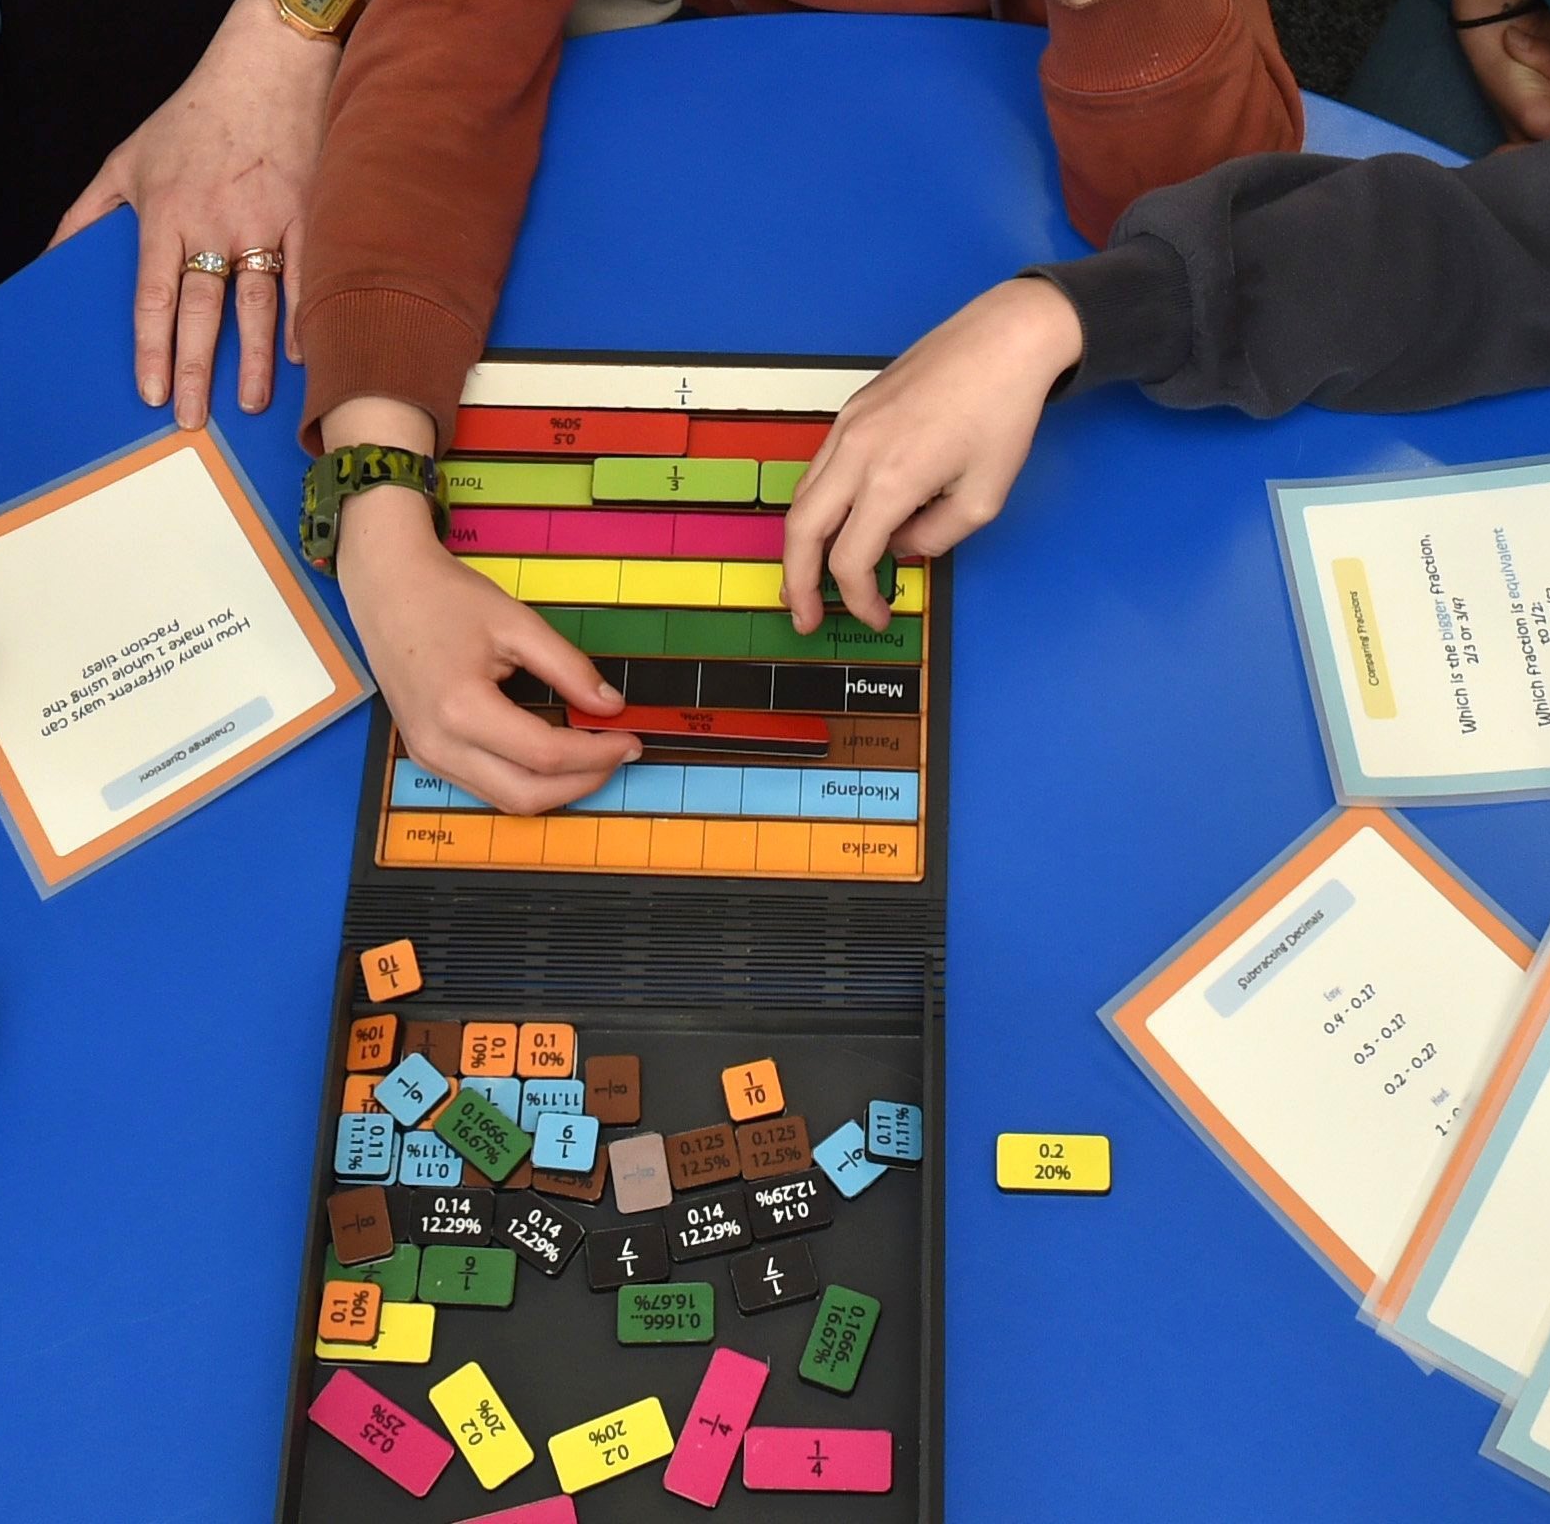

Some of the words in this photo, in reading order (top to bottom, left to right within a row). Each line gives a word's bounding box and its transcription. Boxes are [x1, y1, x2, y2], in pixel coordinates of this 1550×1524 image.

[550, 417, 582, 431] 50%
[553, 433, 576, 446] 0.5
[450, 477, 484, 490] Toru
[449, 529, 479, 543] Wh
[1493, 526, 1521, 600] equivalent
[208, 607, 235, 629] you
[1510, 602, 1524, 614] is
[216, 616, 251, 643] How
[1435, 599, 1454, 642] bigger
[120, 618, 181, 658] fraction
[168, 623, 205, 650] make
[826, 632, 904, 648] Pounamu
[1460, 625, 1473, 641] or
[179, 638, 214, 665] many
[1444, 644, 1460, 669] the
[1463, 644, 1480, 664] 2/3
[1516, 617, 1541, 676] fraction
[82, 653, 118, 680] tiles?
[112, 653, 155, 682] whole
[1450, 672, 1464, 684] is
[70, 677, 110, 703] using
[108, 659, 175, 702] different
[846, 679, 904, 698] Mangu
[42, 699, 68, 718] the
[71, 697, 106, 722] ways
[1454, 687, 1477, 735] Which
[41, 717, 69, 738] can
[188, 721, 236, 754] Challenge
[843, 736, 900, 750] Parauri
[414, 777, 443, 792] Iwa
[820, 780, 900, 801] Kikorangi
[406, 828, 456, 846] Tekau
[842, 841, 898, 858] Karaka
[1237, 942, 1290, 991] Subtracting
[1284, 909, 1325, 947] Decimals
[1323, 1013, 1345, 1034] 0.4
[1350, 984, 1376, 1009] 0.1?
[356, 1026, 385, 1043] 10%
[534, 1033, 556, 1048] 0.1
[1353, 1043, 1376, 1064] 0.5
[1380, 1013, 1406, 1039] 0.1?
[361, 1044, 381, 1060] 0.1
[471, 1035, 488, 1069] 10%
[491, 1037, 506, 1060] 0.1
[530, 1051, 565, 1067] 10%
[1384, 1073, 1407, 1095] 0.2
[1411, 1042, 1437, 1069] 0.2?
[526, 1092, 580, 1107] 11.11%
[368, 1126, 385, 1158] 0.11
[452, 1119, 499, 1165] 16.67%
[752, 1126, 797, 1146] 0.125
[876, 1115, 892, 1145] 0.11
[895, 1107, 910, 1155] 11.11%
[348, 1117, 366, 1171] 11.11%
[680, 1133, 725, 1156] 0.125
[1039, 1143, 1065, 1159] 0.2
[680, 1154, 730, 1178] 12.5%
[752, 1147, 802, 1167] 12.5%
[416, 1163, 449, 1179] 0.11
[1035, 1164, 1072, 1181] 20%
[434, 1197, 471, 1214] 0.14
[755, 1180, 818, 1208] 12.29%
[527, 1209, 563, 1239] 0.14
[687, 1203, 725, 1225] 0.14
[772, 1202, 810, 1224] 0.14
[421, 1217, 482, 1234] 12.29%
[679, 1219, 742, 1248] 12.29%
[507, 1218, 560, 1263] 12.29%
[330, 1299, 349, 1323] 0.1
[349, 1289, 370, 1327] 10%
[634, 1293, 696, 1312] 16.67%
[812, 1304, 846, 1365] 16.67%
[371, 1404, 406, 1436] 25%
[476, 1399, 507, 1437] 20%
[360, 1423, 394, 1454] 0.25
[460, 1418, 483, 1446] 0.2
[588, 1420, 628, 1447] 20%
[601, 1444, 630, 1466] 0.2
